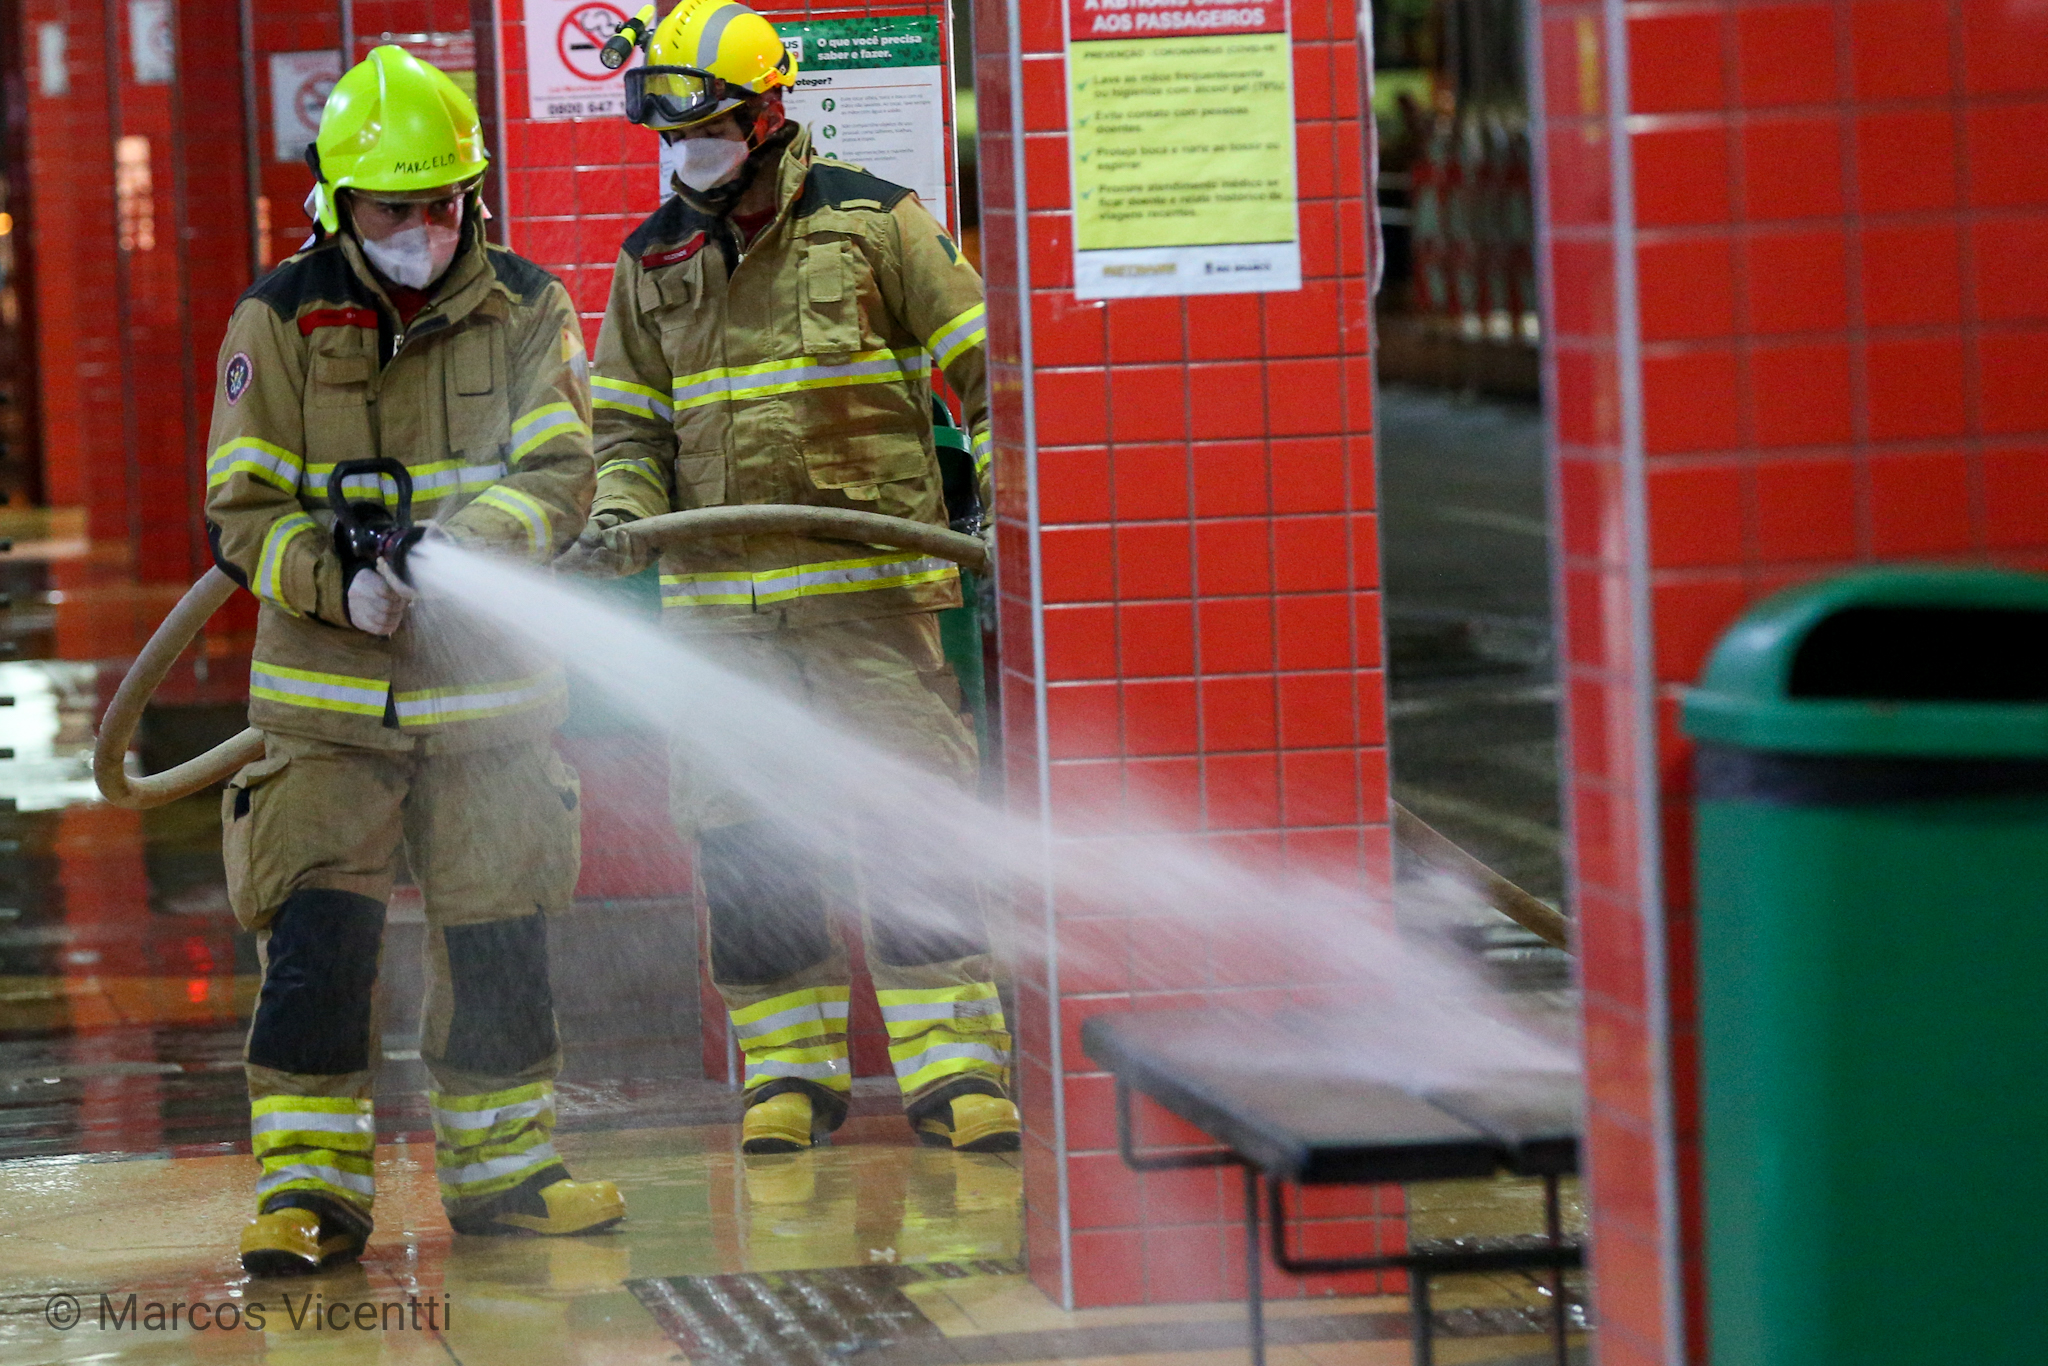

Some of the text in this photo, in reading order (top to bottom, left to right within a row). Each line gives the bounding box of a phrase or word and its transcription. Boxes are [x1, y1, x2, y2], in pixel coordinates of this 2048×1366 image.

[1092, 8, 1266, 32] AOS PASSAGEIROS
[817, 34, 922, 48] O que você precisa
[817, 50, 849, 61] saber
[860, 49, 892, 59] fazer.
[394, 153, 456, 174] MARCELO
